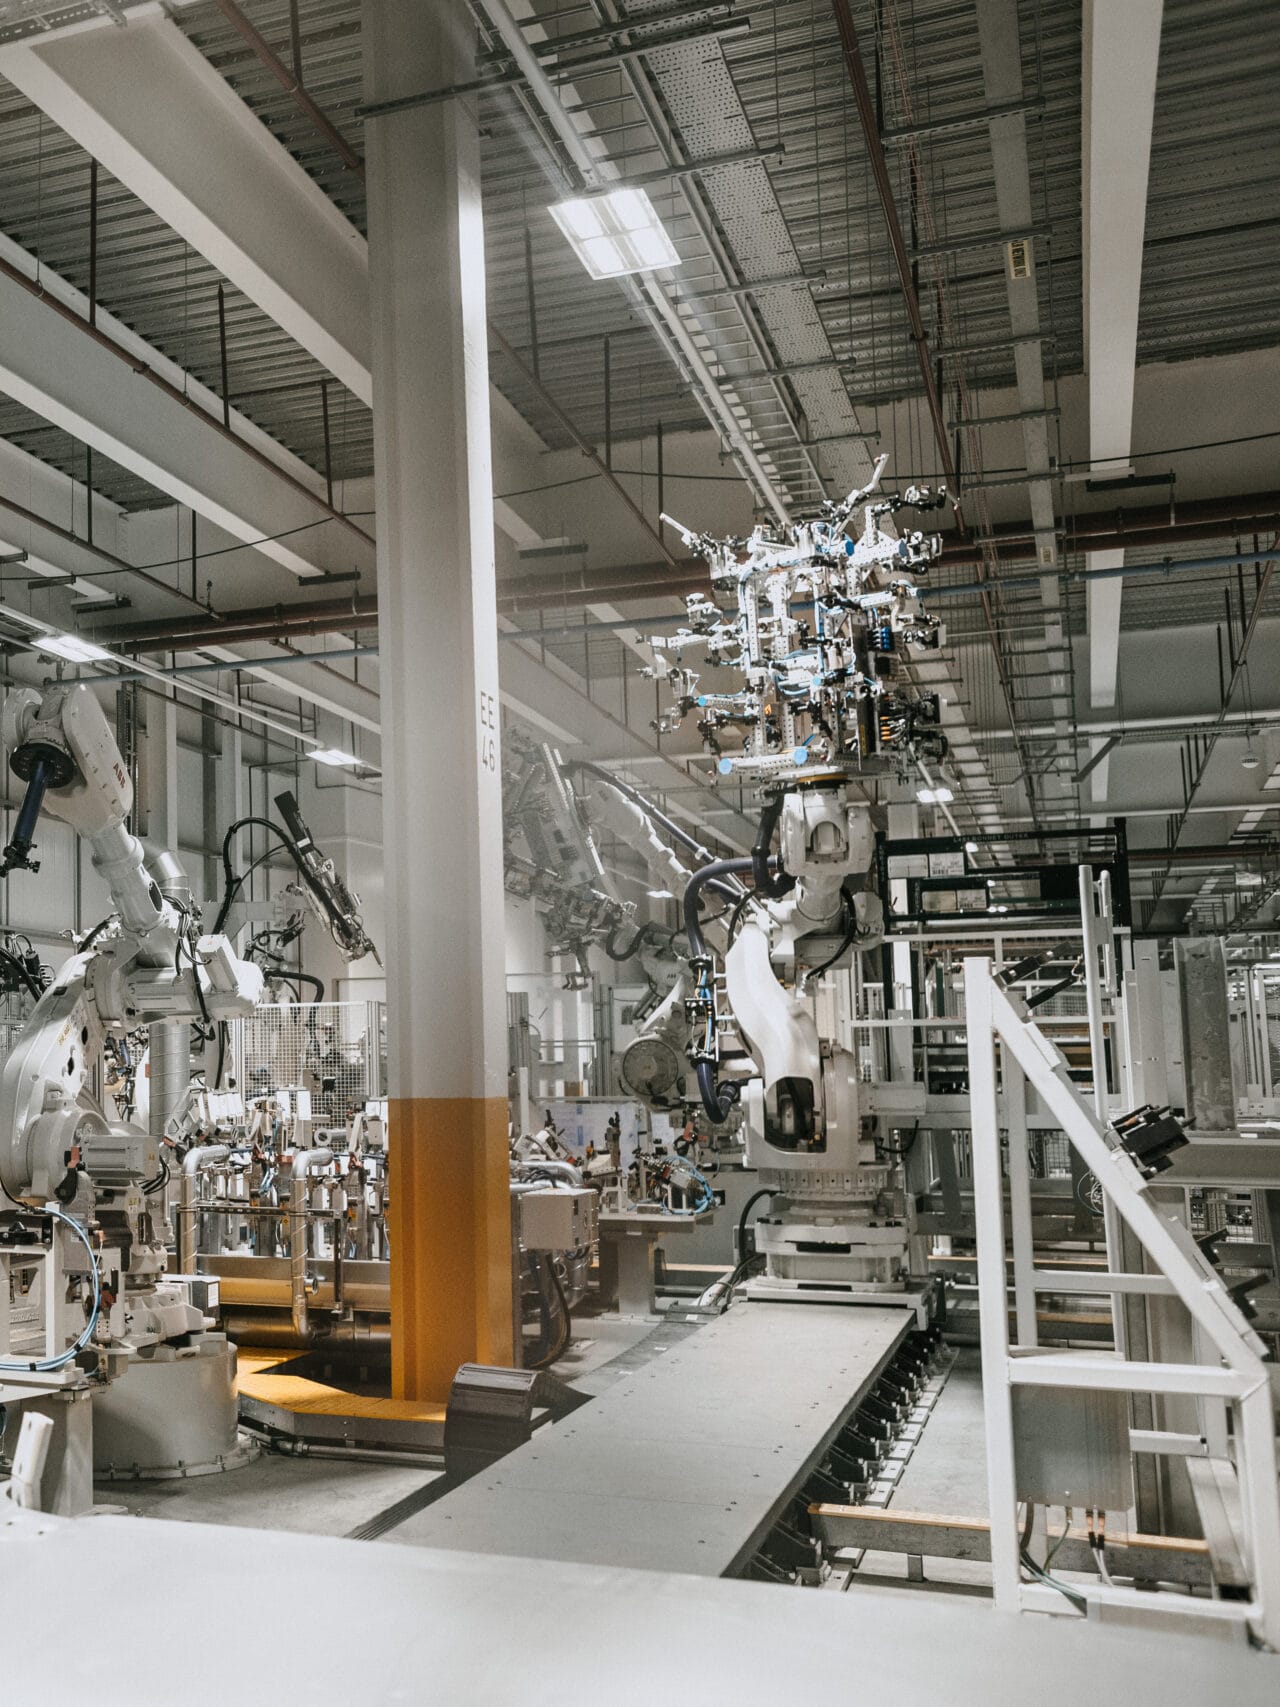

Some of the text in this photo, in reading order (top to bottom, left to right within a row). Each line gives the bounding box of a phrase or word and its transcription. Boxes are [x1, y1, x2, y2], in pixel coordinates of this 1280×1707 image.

[480, 690, 495, 730] EE
[482, 735, 495, 773] 46
[113, 762, 126, 789] ABB
